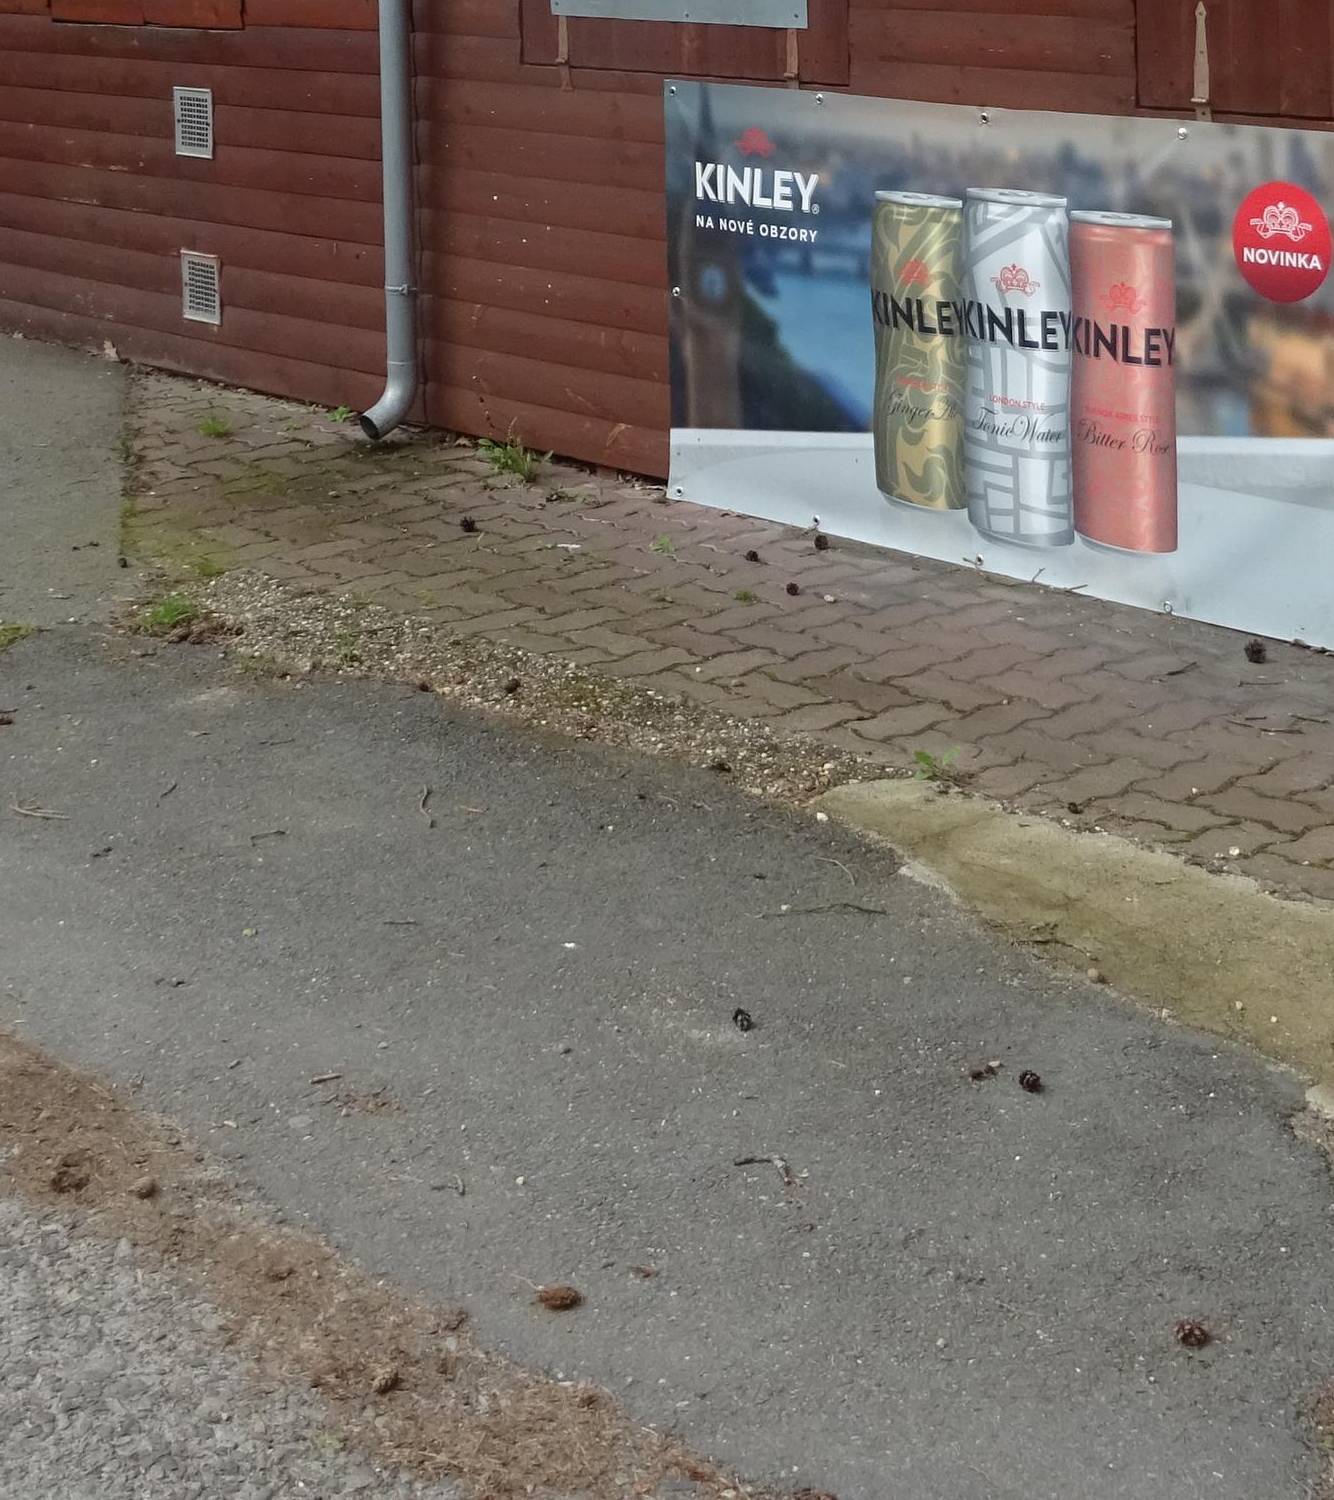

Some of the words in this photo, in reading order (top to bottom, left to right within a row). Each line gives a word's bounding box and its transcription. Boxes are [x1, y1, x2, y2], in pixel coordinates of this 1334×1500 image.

[696, 215, 714, 229] NA
[719, 218, 754, 235] NOVÉ
[759, 224, 818, 243] OBZORY
[1243, 247, 1322, 271] NOVINKA
[962, 298, 1072, 351] KINLEY
[1071, 316, 1176, 367] KINLEY
[989, 395, 1021, 407] LONDON
[972, 406, 1014, 437] Tonic
[1013, 413, 1065, 443] Water
[1077, 419, 1127, 450] Bitter
[1132, 428, 1170, 454] Ros
